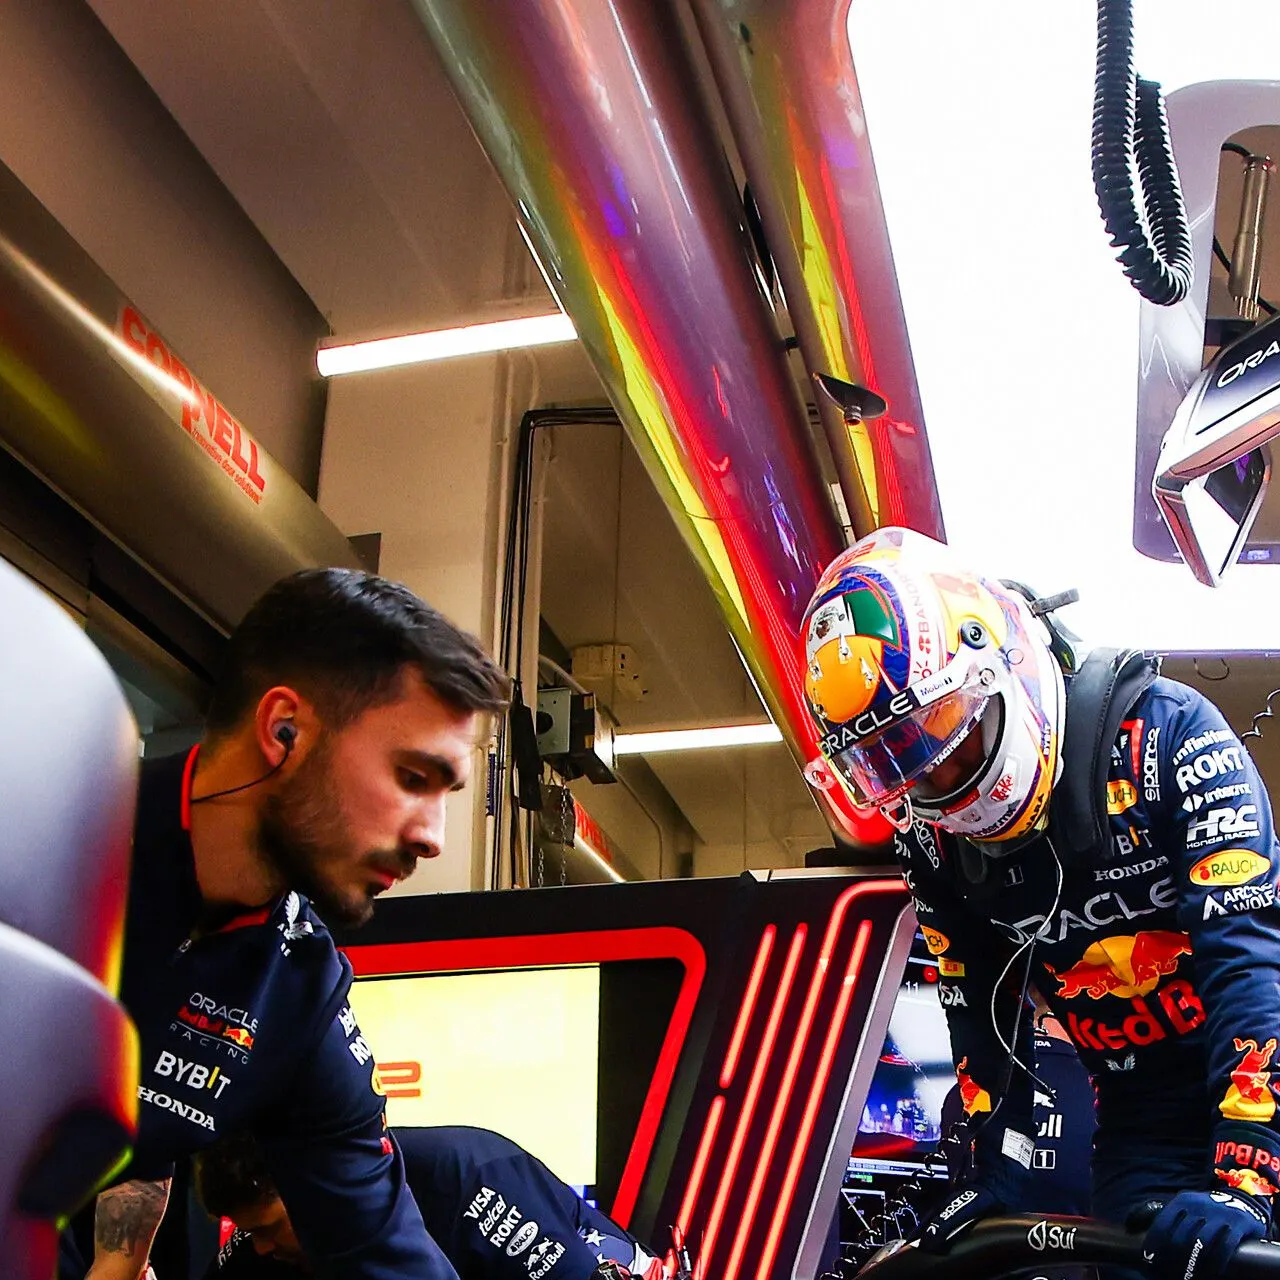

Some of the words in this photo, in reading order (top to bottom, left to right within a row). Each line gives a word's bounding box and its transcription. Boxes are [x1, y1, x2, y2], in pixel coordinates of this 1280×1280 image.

[820, 692, 914, 758] ORACLE
[1143, 727, 1161, 802] sparco
[1175, 747, 1246, 794] ROKT
[914, 819, 940, 870] parco
[1116, 826, 1152, 856] BIT
[1186, 804, 1259, 843] HRC
[1094, 855, 1169, 882] HONDA
[1211, 858, 1261, 876] RAUCH
[189, 992, 259, 1034] ORACLE
[170, 1022, 250, 1066] RACING
[154, 1051, 231, 1099] BYBIT
[136, 1086, 216, 1132] HONDA
[463, 1186, 496, 1219] VISA
[478, 1194, 507, 1237] telcel
[939, 1190, 978, 1221] sparco
[489, 1205, 522, 1248] ROKT
[515, 1224, 536, 1250] RAUCH
[1048, 1226, 1077, 1250] Sui
